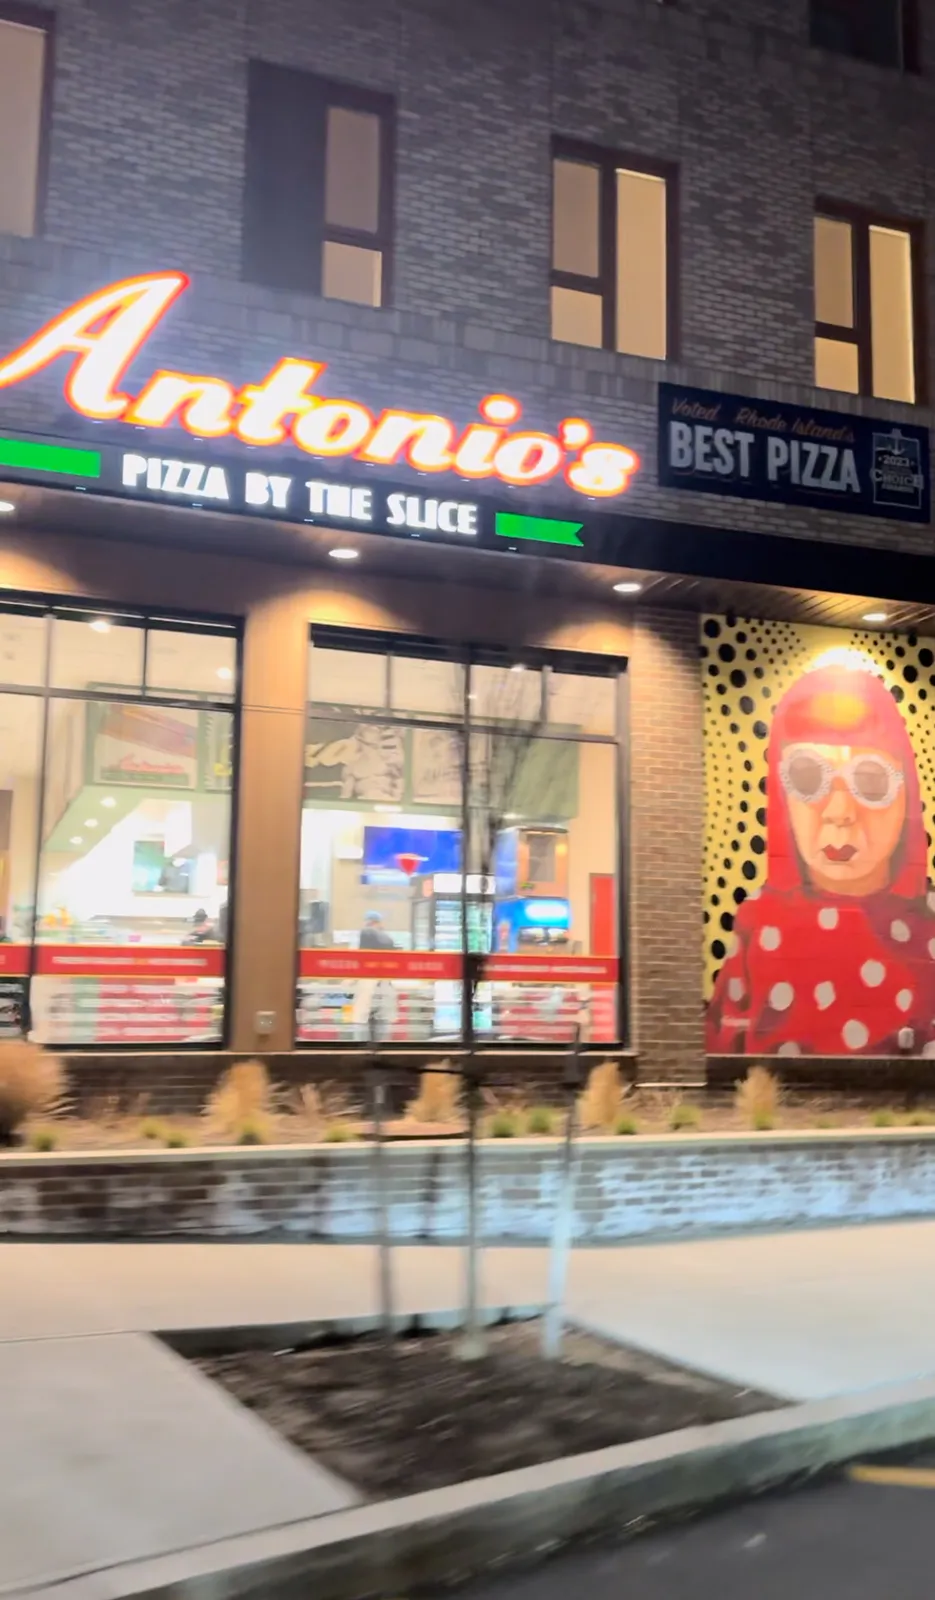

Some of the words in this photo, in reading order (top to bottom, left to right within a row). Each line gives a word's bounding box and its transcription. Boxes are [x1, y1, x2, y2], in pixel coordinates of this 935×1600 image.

[0, 270, 640, 497] Antonio's
[671, 398, 723, 422] Voted
[734, 407, 788, 432] Rhode
[122, 453, 230, 500] PIZZA
[245, 467, 292, 509] BY
[304, 481, 373, 521] THE
[386, 493, 478, 536] SLICE
[669, 420, 755, 478] BEST
[767, 436, 861, 494] PIZZA
